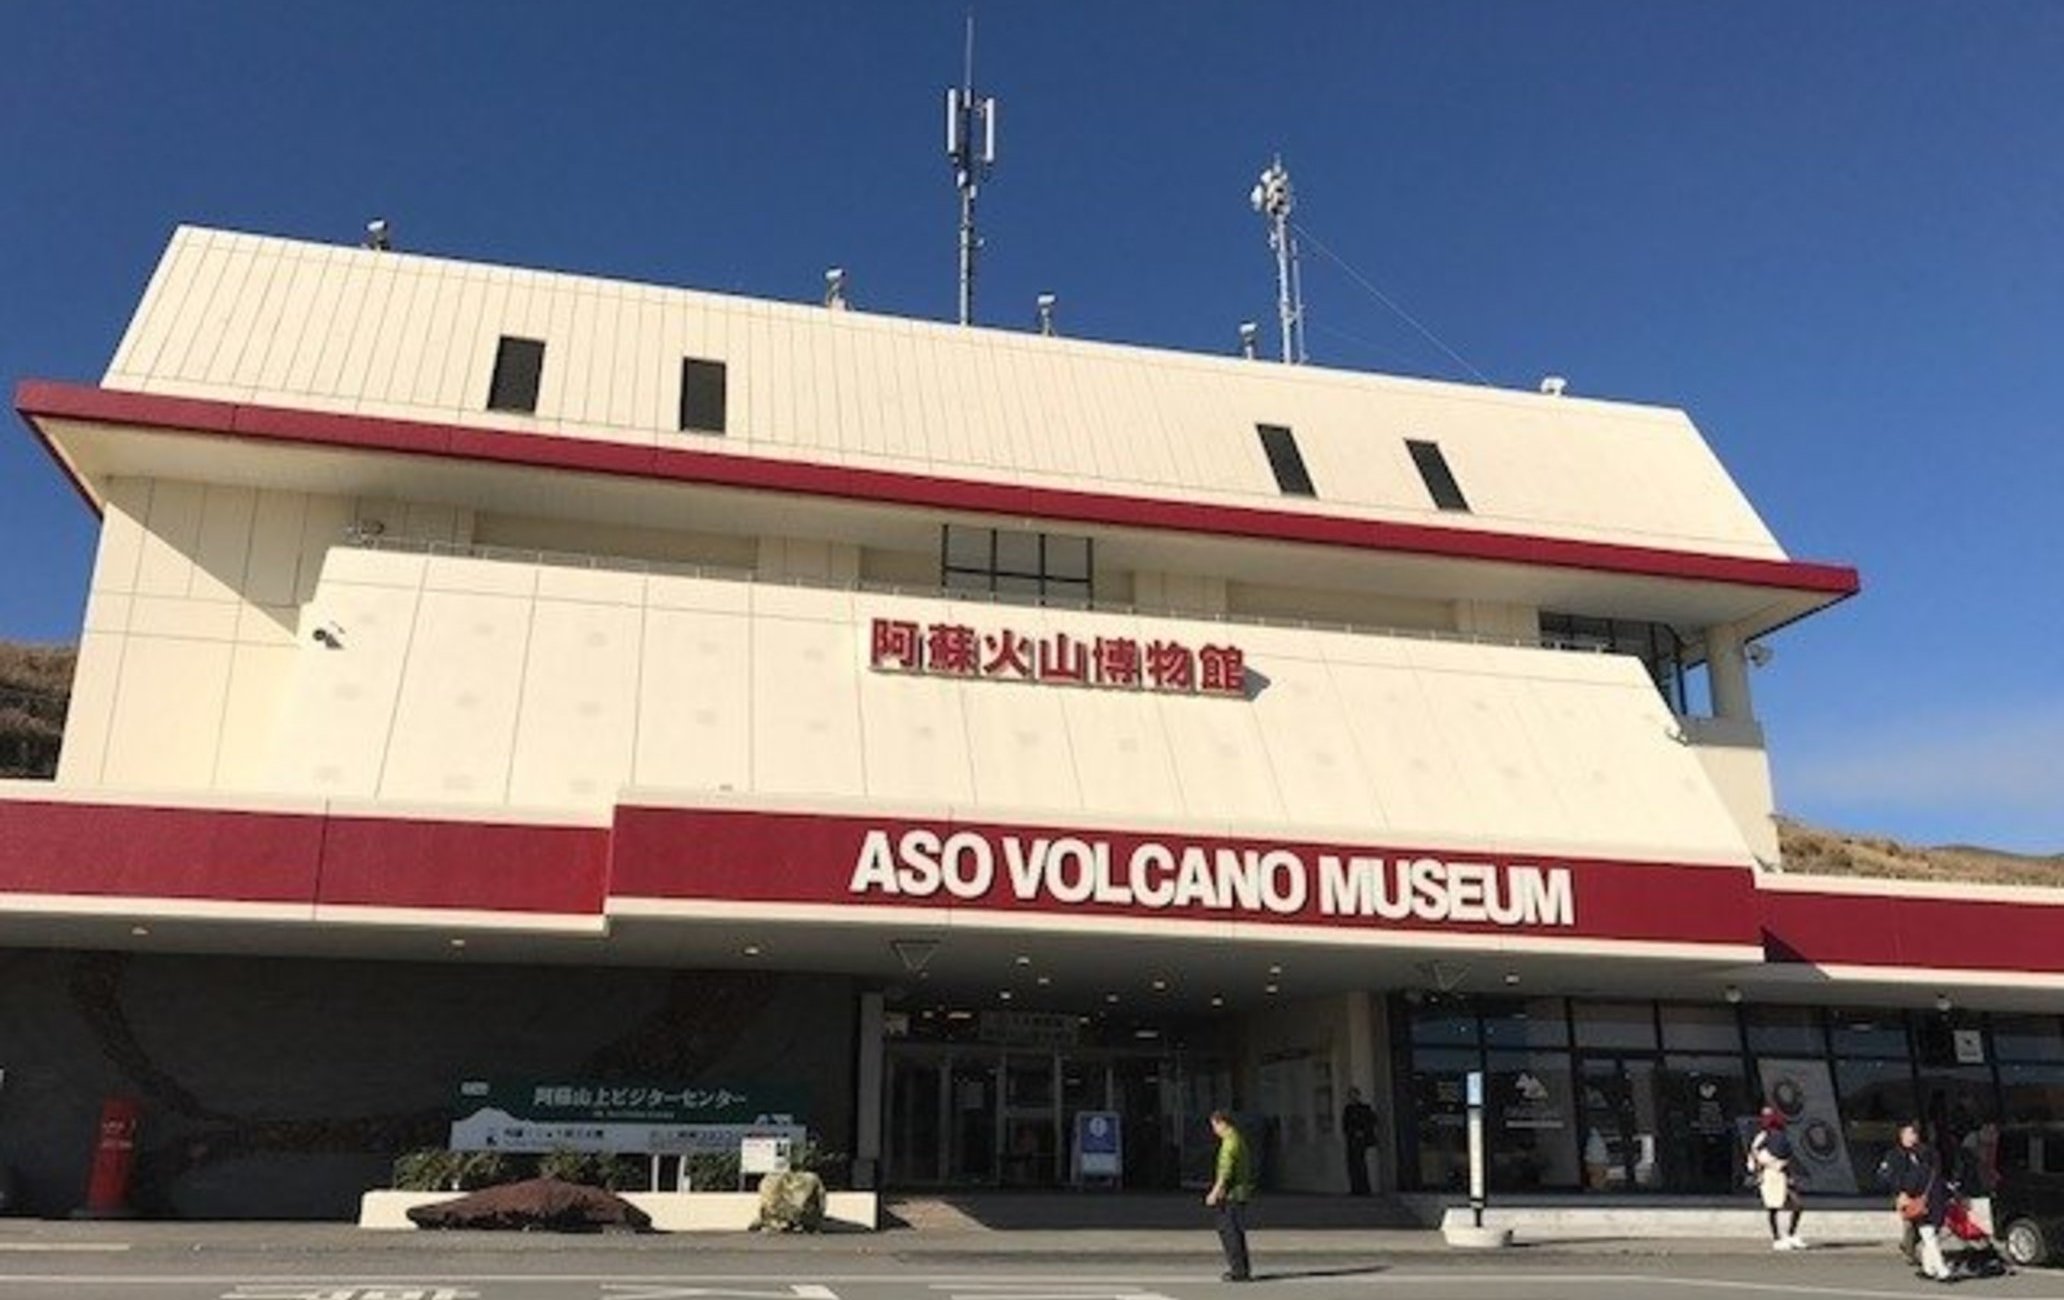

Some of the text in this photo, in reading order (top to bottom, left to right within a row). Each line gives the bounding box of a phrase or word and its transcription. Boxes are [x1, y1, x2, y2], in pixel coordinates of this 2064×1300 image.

[870, 618, 1246, 694] 阿蘇火山博物館
[849, 830, 1574, 927] ASO VOLCANO MUSEUM
